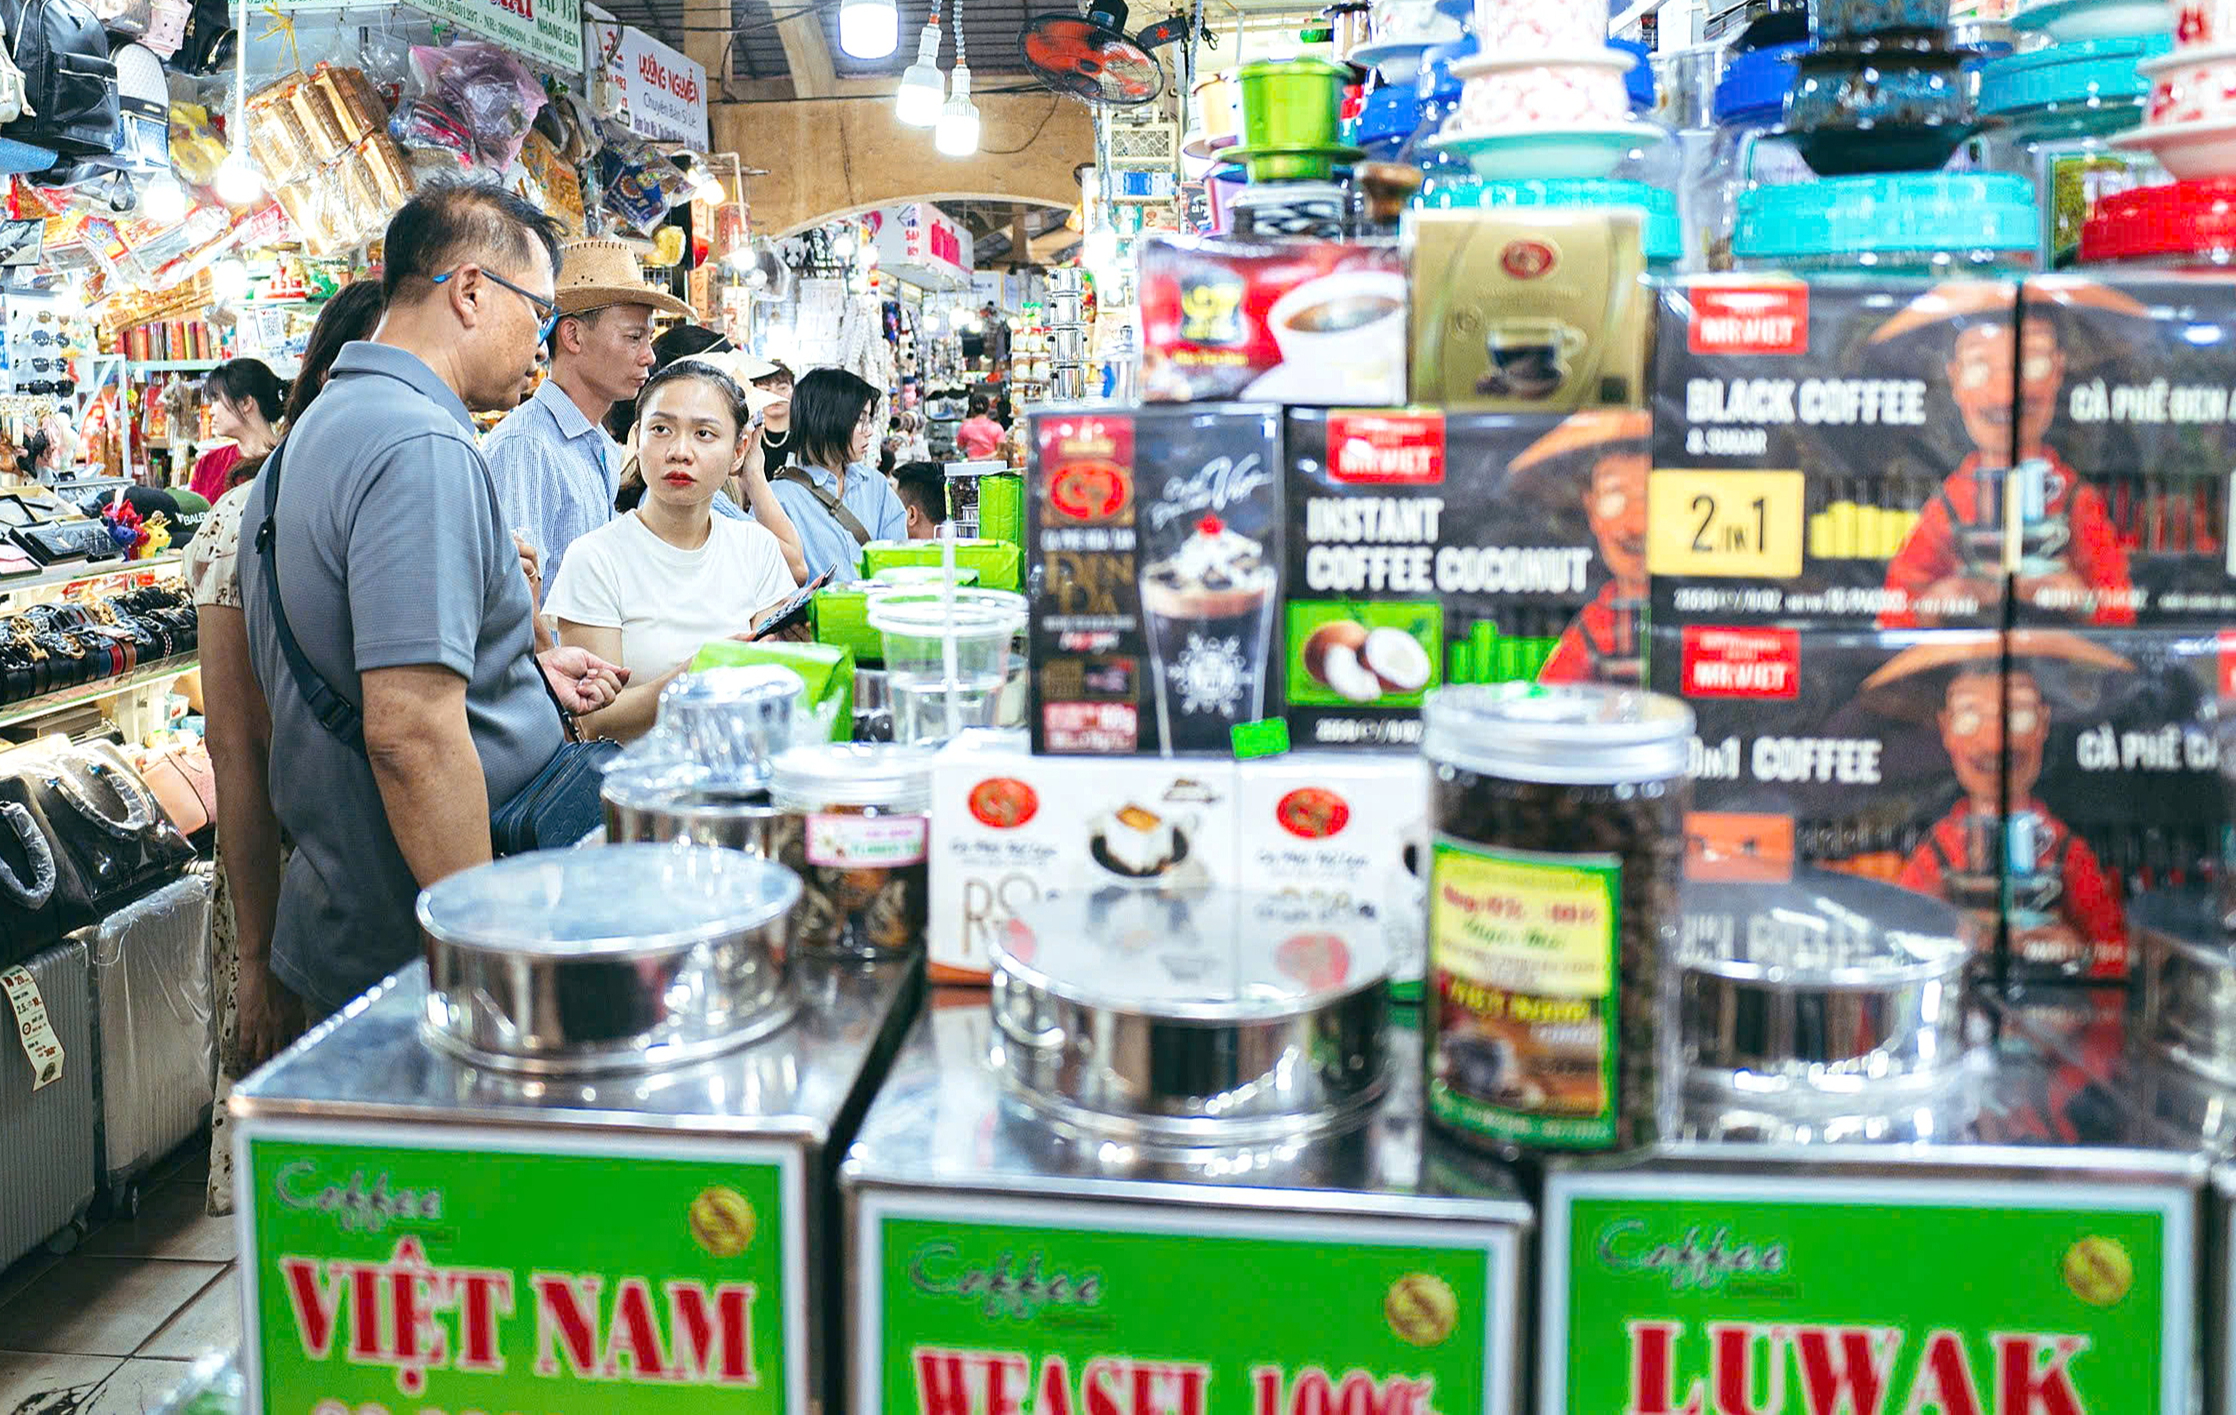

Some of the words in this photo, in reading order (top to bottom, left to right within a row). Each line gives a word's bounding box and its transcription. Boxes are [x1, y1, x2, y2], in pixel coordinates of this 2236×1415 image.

[537, 17, 563, 42] NHANG
[1686, 377, 1796, 424] BLACK
[1799, 378, 1927, 426] COFFEE
[1306, 497, 1445, 543] INSTANT
[1306, 544, 1434, 592] COFFEE
[1435, 546, 1593, 593] COCONUT
[1752, 736, 1883, 784] COFFEE
[2076, 721, 2120, 770] CÀ
[2121, 721, 2183, 770] PHÊ
[275, 1158, 442, 1233] Coffee
[1598, 1219, 1787, 1290] Coffee
[908, 1242, 1102, 1320] Coffee
[280, 1236, 515, 1396] VIỆT
[531, 1270, 760, 1389] NAM
[1623, 1317, 2092, 1415] LUWAK
